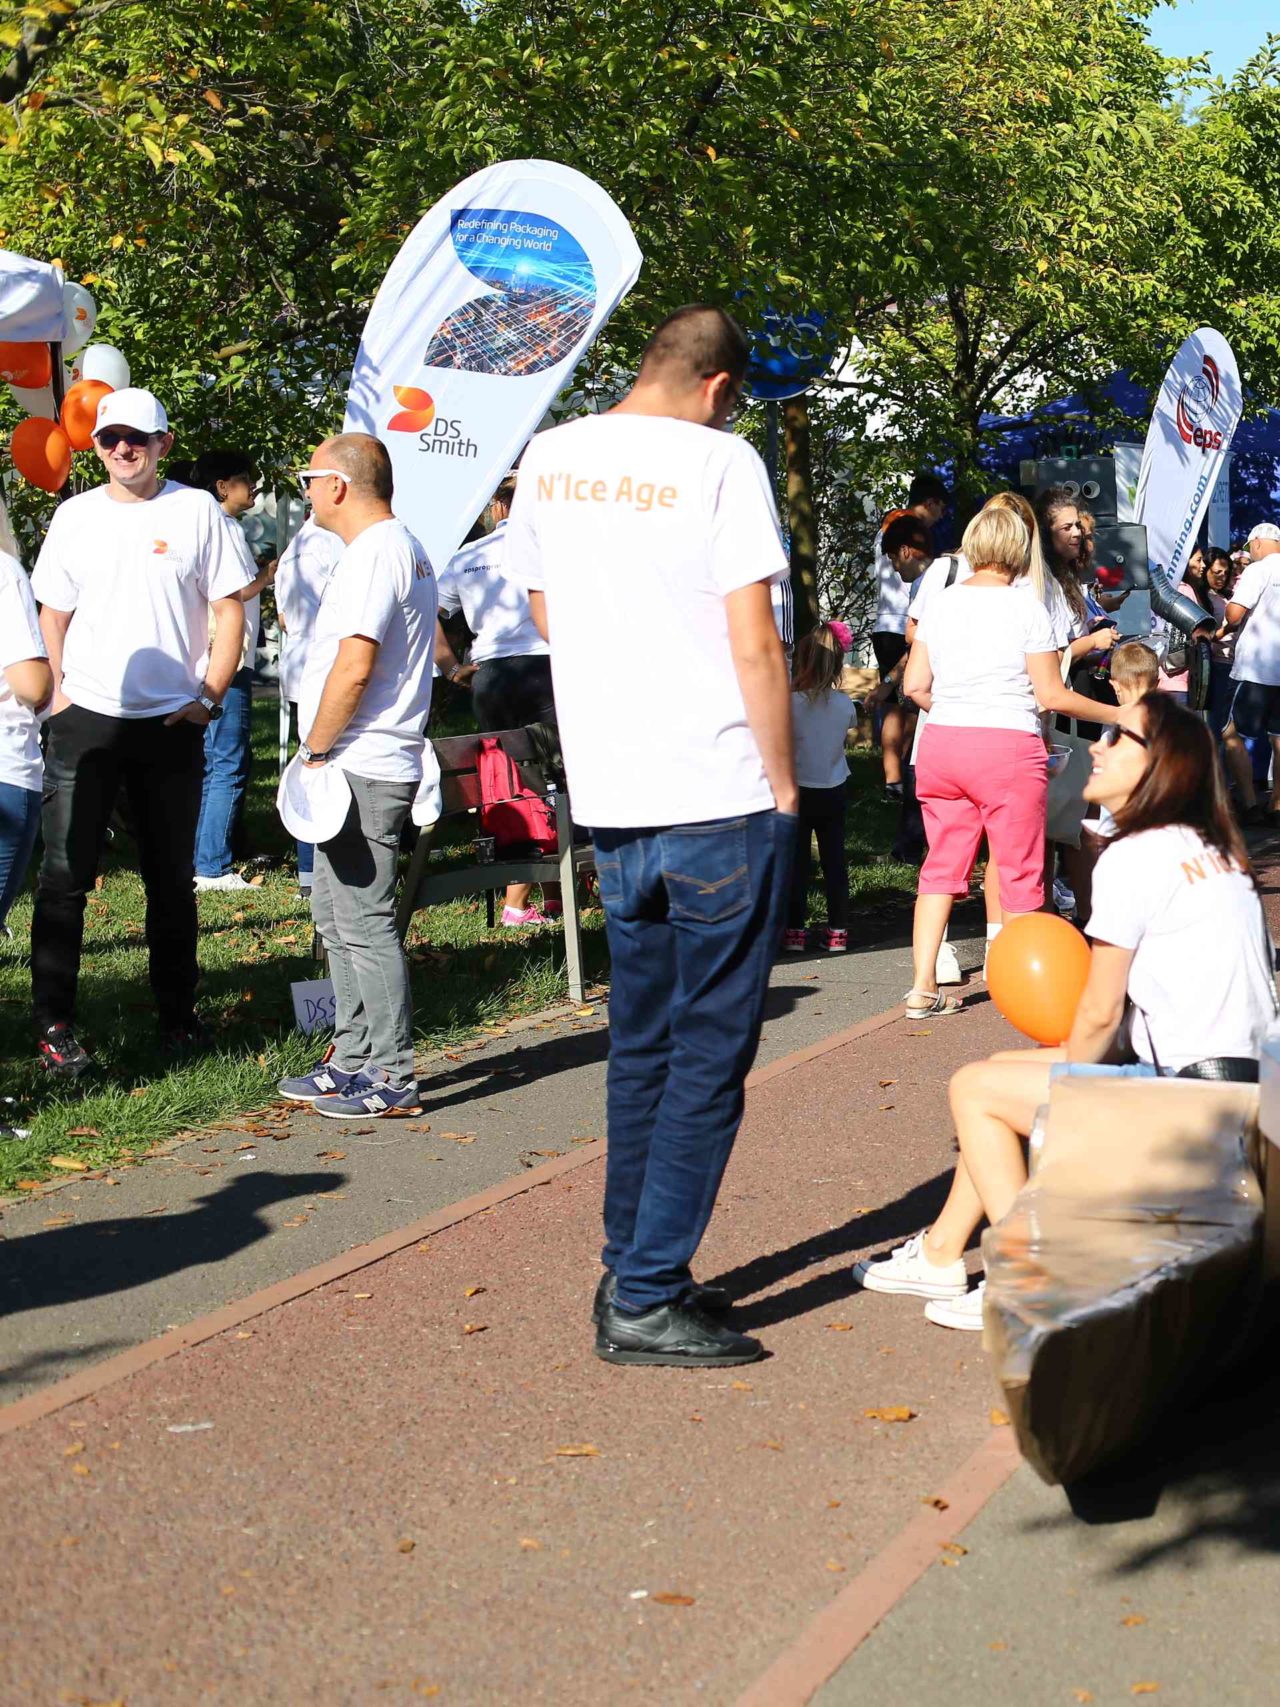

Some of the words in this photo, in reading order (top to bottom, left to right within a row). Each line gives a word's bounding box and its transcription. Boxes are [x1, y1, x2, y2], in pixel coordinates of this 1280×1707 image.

[457, 219, 508, 233] Redefining
[509, 222, 559, 240] Packaging
[455, 233, 468, 242] for
[476, 233, 522, 249] Changing
[523, 238, 553, 251] World
[434, 418, 461, 439] DS
[418, 432, 478, 458] Smith
[1193, 427, 1222, 454] eps
[537, 473, 607, 501] N'Ice
[615, 475, 678, 511] Age
